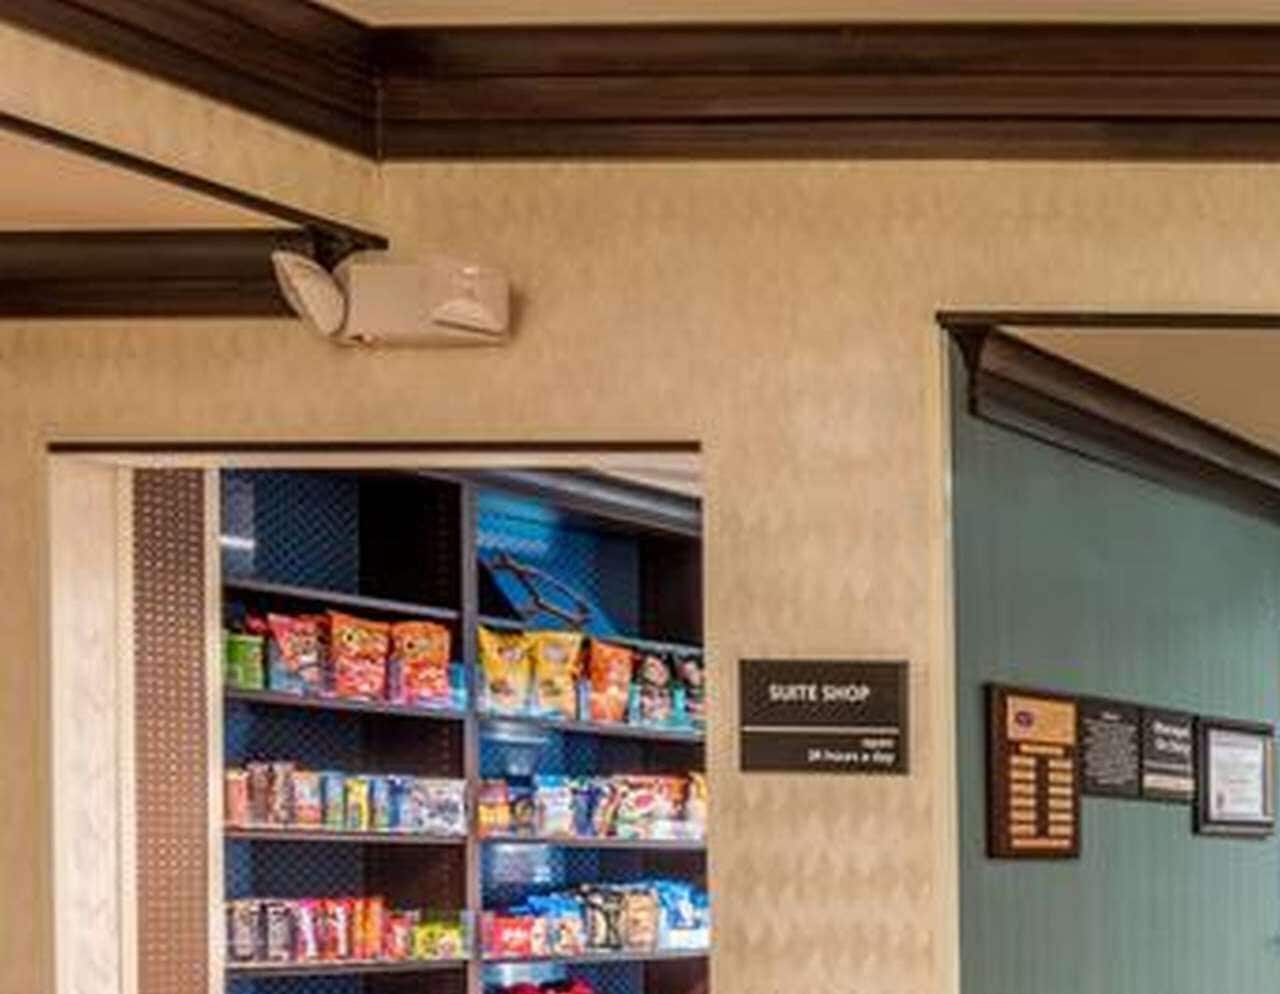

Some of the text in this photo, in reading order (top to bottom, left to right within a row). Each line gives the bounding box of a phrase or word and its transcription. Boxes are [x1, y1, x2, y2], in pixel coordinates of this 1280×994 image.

[768, 683, 871, 703] SUITE SHOP
[824, 750, 858, 763] hours
[872, 751, 896, 765] day
